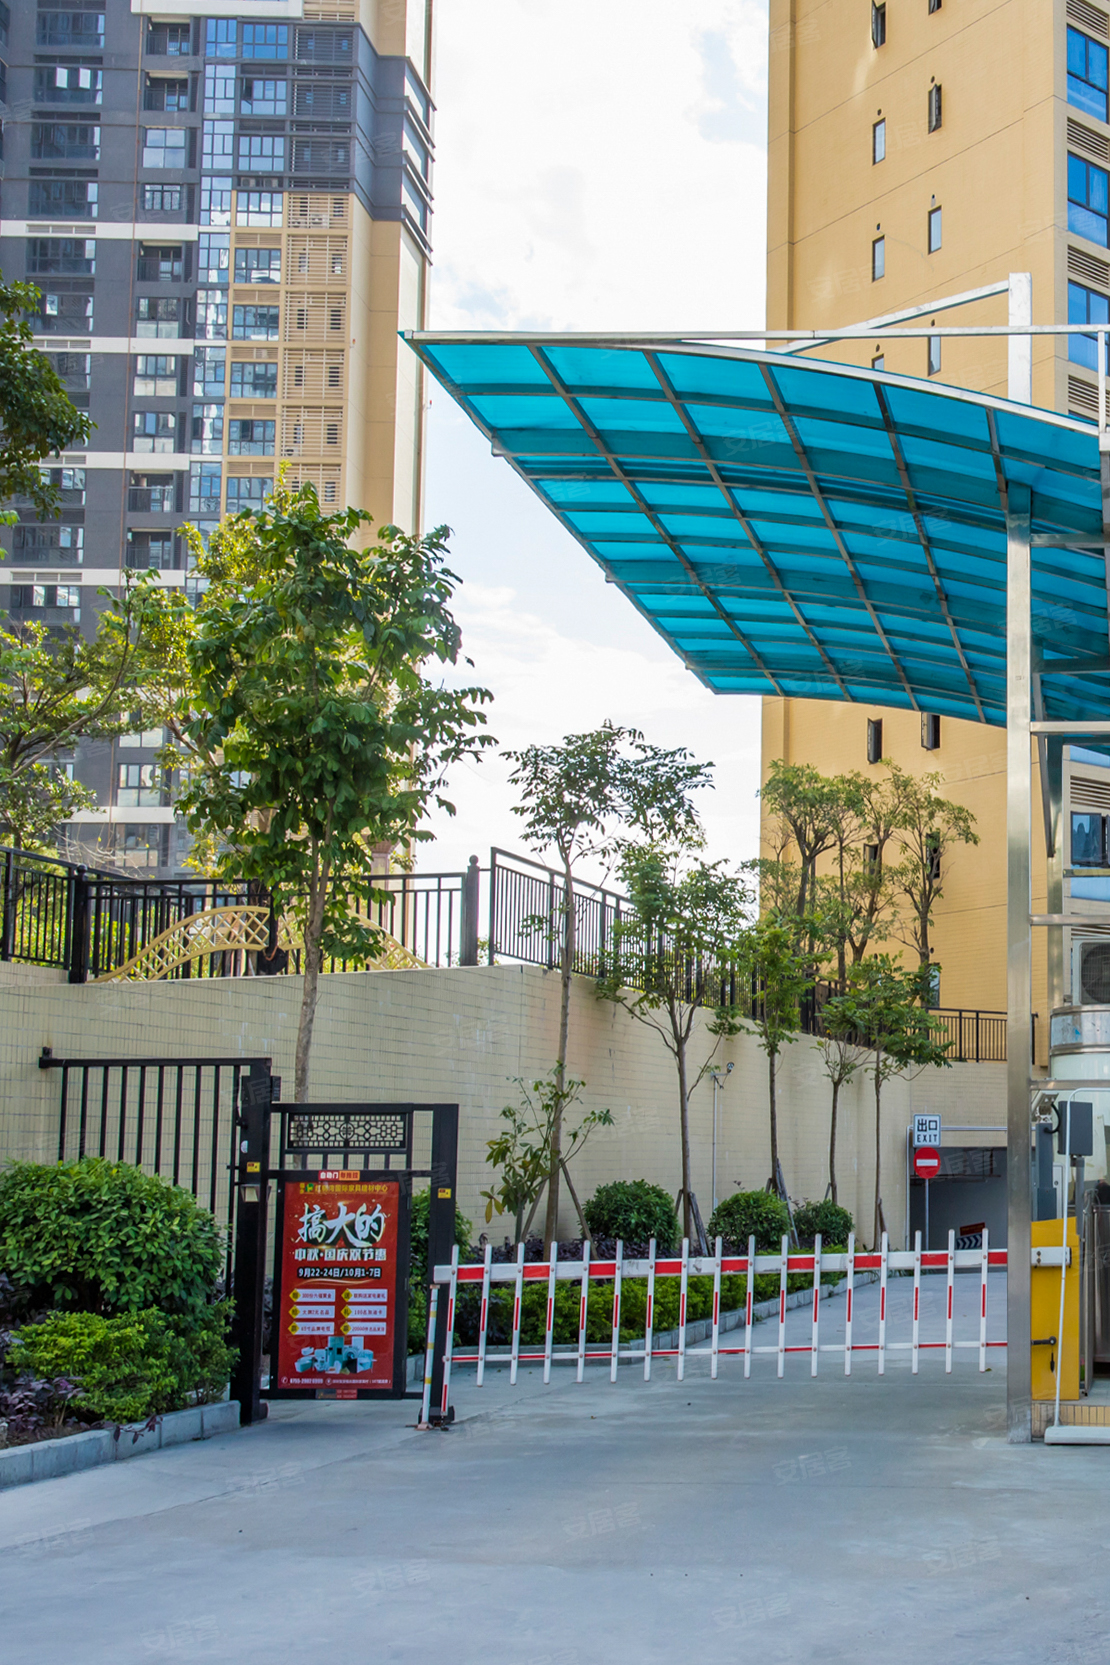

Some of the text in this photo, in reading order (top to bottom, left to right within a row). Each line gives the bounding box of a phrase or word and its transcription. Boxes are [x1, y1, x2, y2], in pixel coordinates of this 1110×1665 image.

[917, 1118, 938, 1132] 出口
[917, 1134, 938, 1143] EXIT
[295, 1202, 386, 1248] 搞大的
